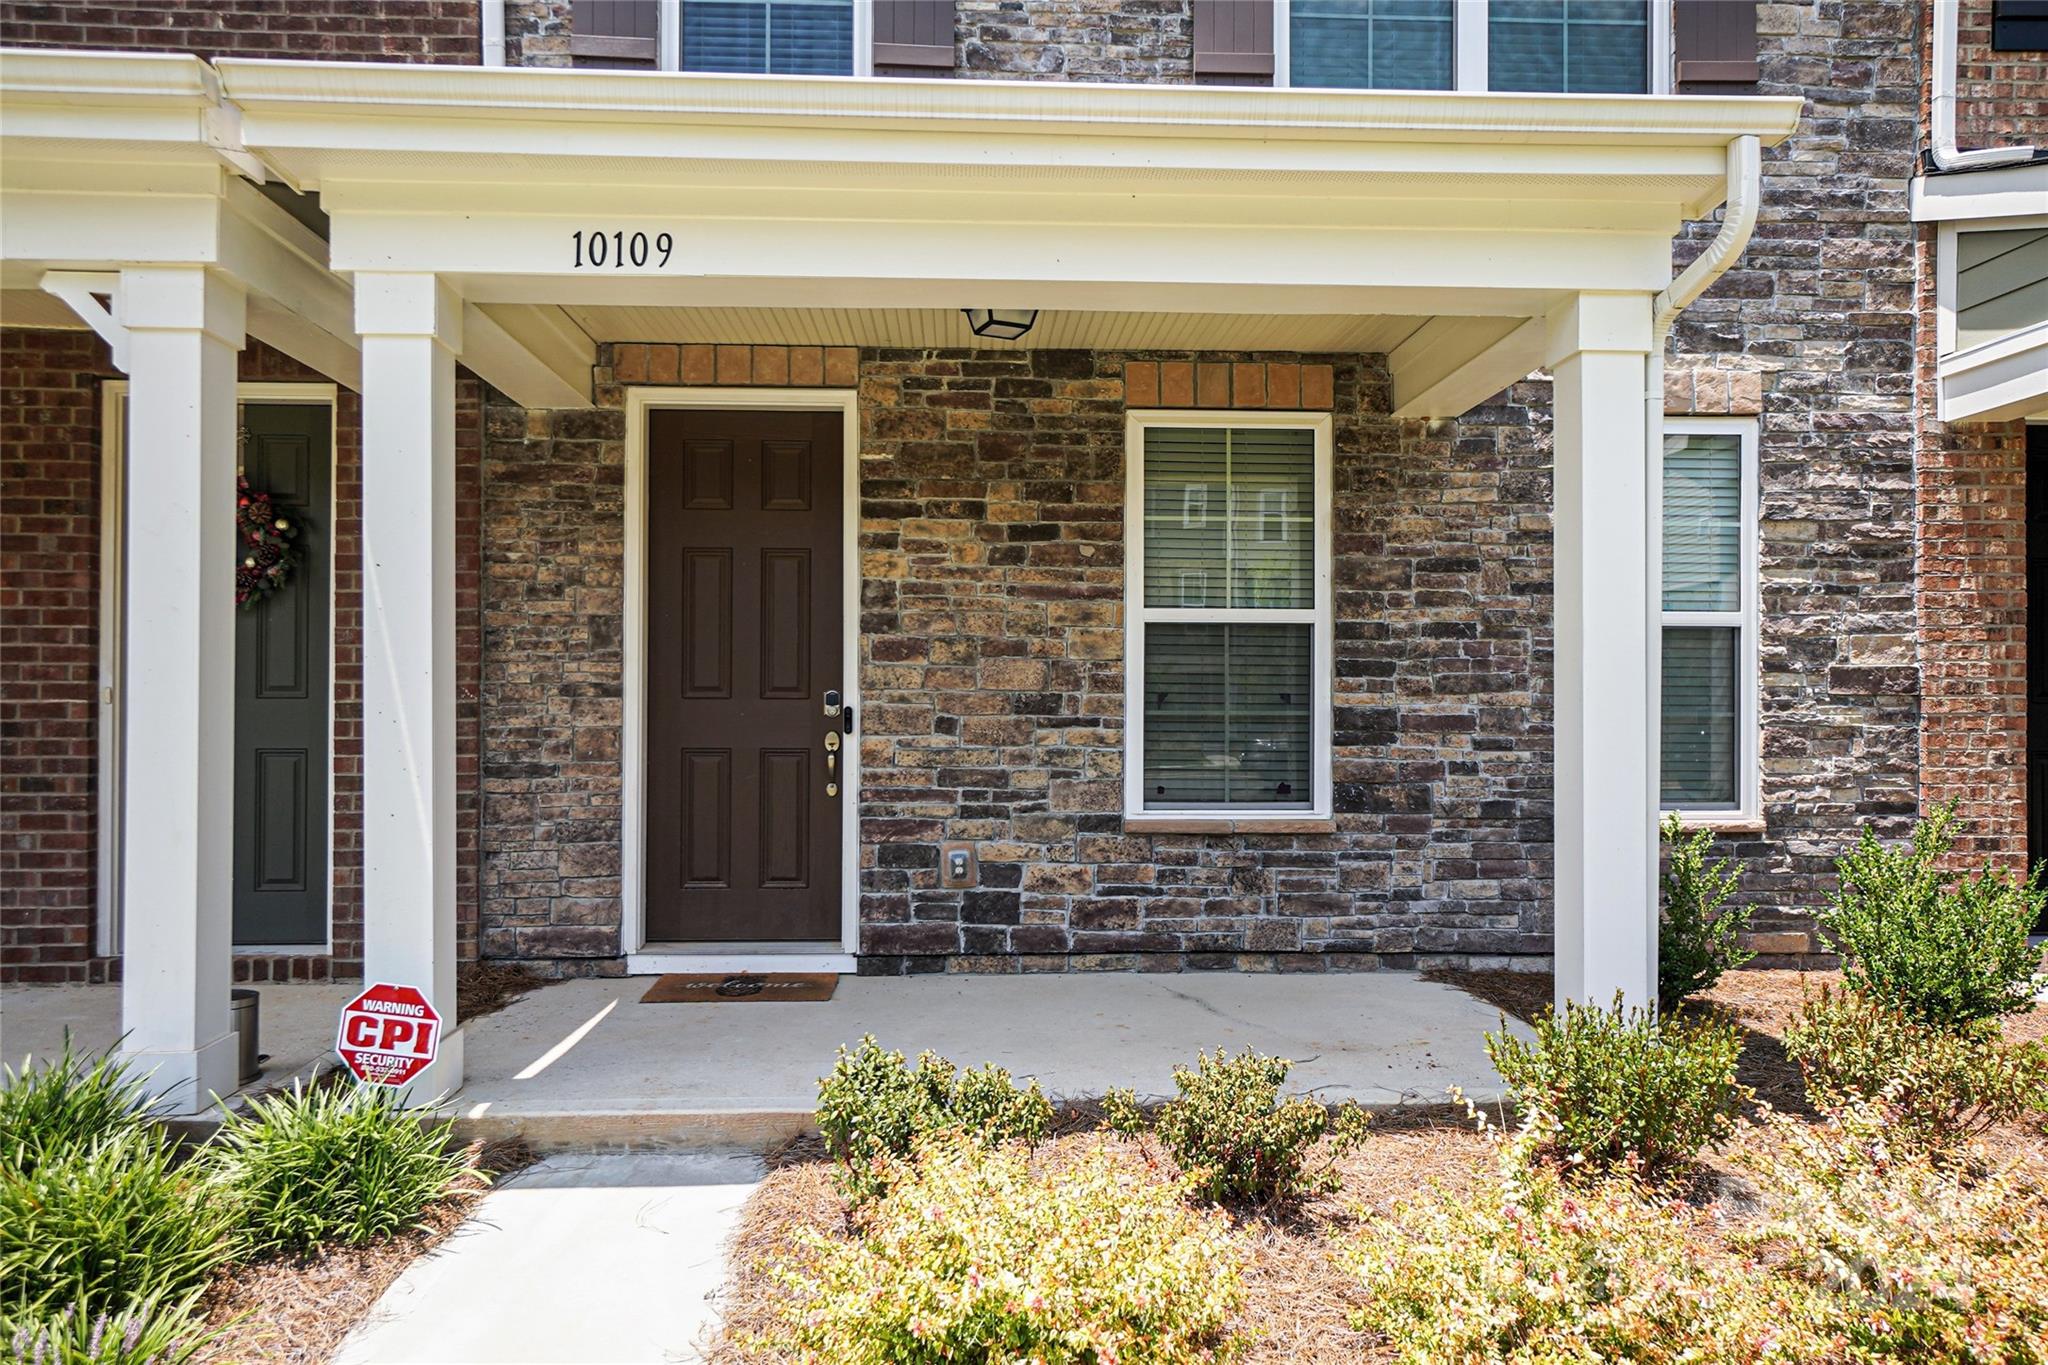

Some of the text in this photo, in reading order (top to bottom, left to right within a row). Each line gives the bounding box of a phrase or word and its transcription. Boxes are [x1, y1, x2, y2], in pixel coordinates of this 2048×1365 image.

[573, 230, 673, 268] 10109
[362, 999, 425, 1016] WARNING
[346, 1015, 433, 1054] CPI
[354, 1052, 415, 1069] SECURITY
